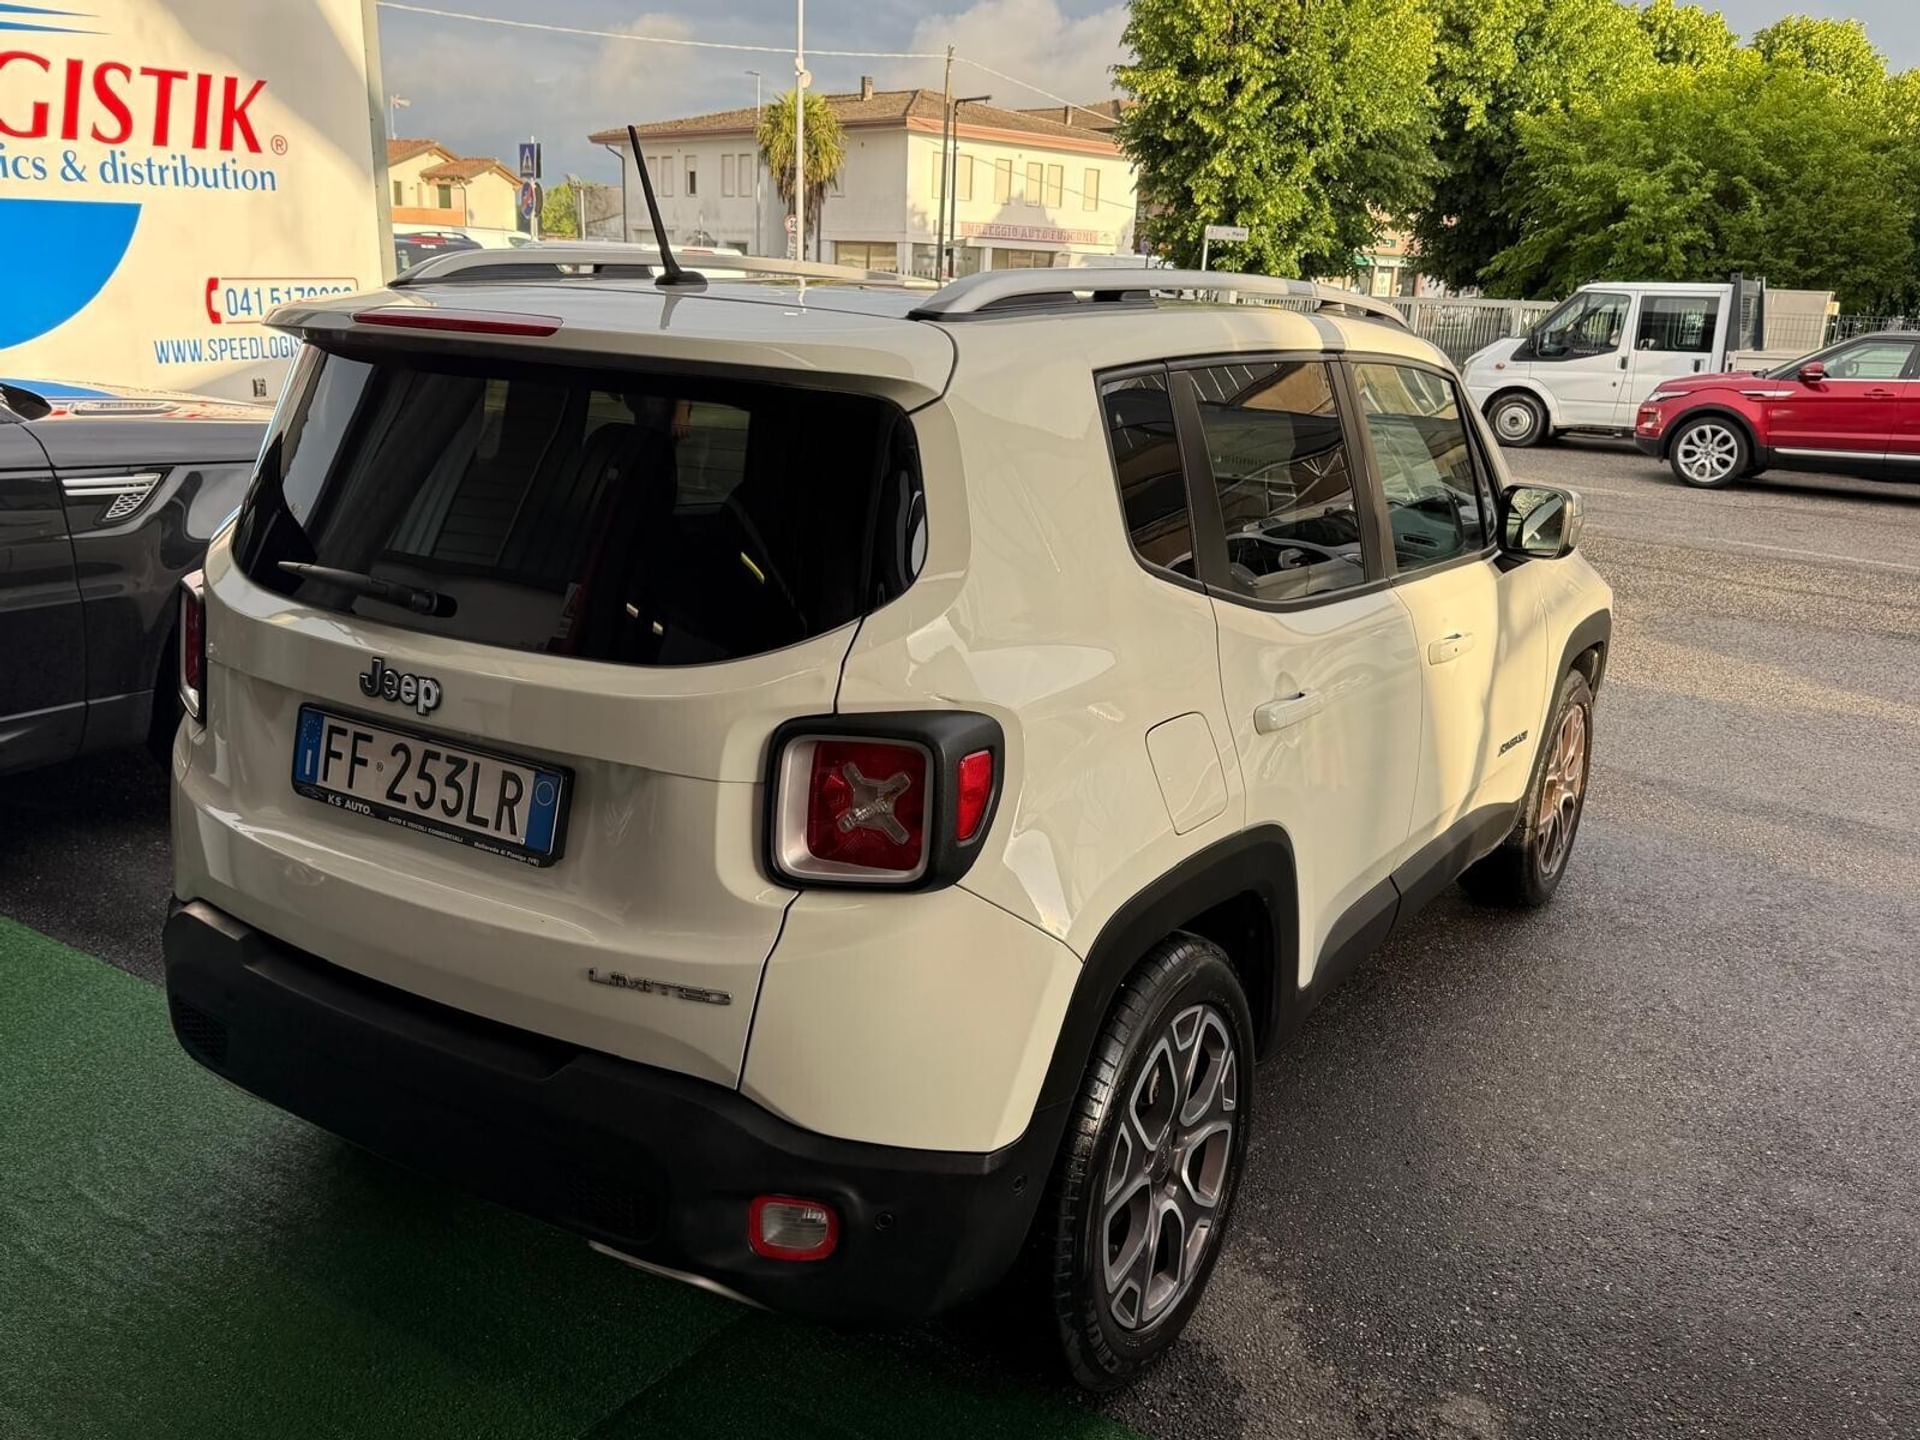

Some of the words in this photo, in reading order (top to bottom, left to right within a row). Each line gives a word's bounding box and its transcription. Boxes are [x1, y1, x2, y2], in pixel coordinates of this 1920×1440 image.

[60, 149, 88, 183] &
[100, 150, 277, 192] distribution
[226, 287, 264, 316] 041
[360, 656, 442, 717] Jeep
[322, 724, 374, 789] FF
[385, 742, 524, 836] 253LR
[327, 793, 342, 807] KS
[344, 800, 371, 815] AUTO
[588, 967, 732, 1006] LIMITED
